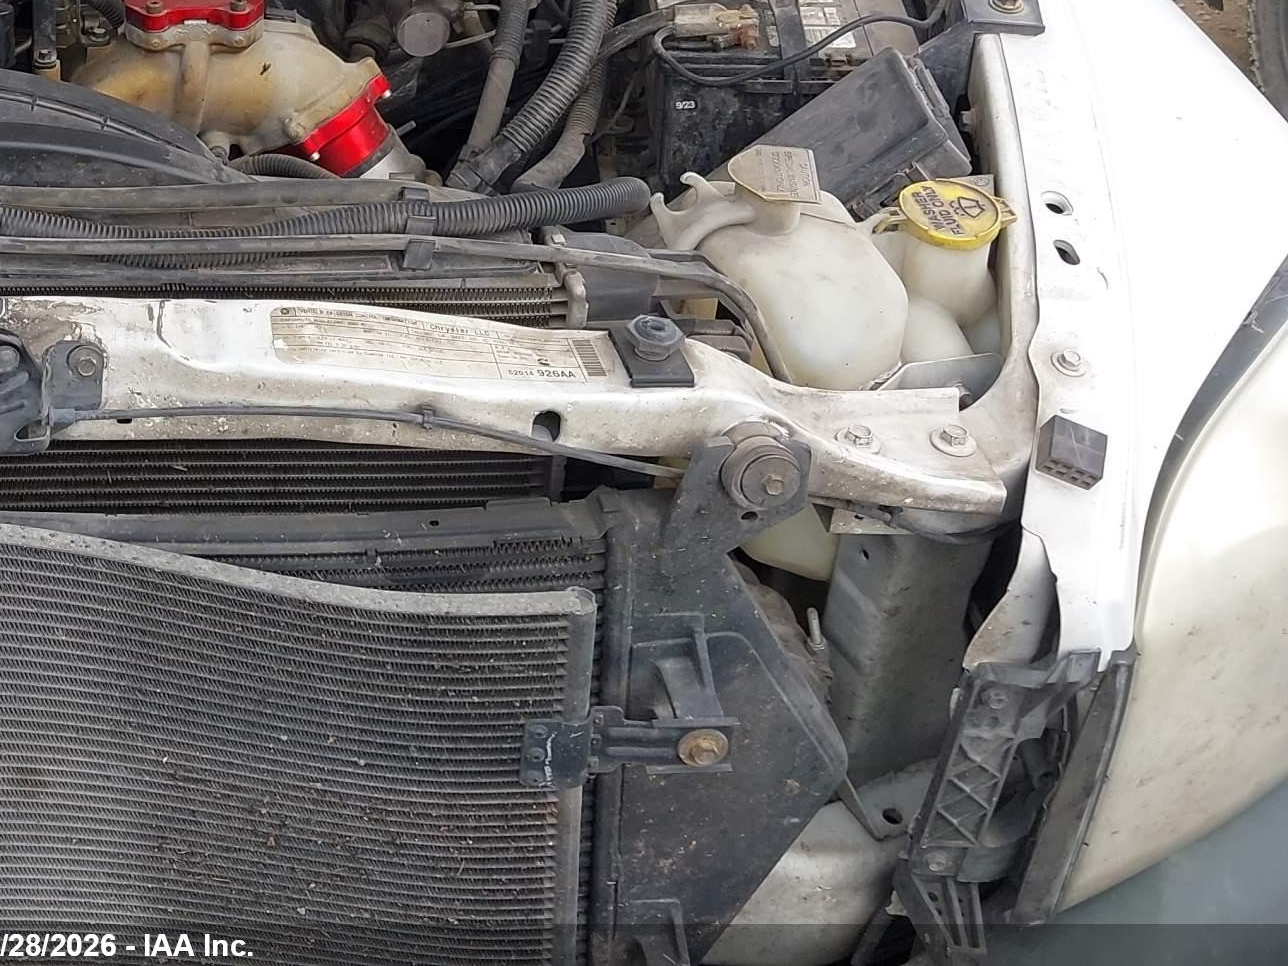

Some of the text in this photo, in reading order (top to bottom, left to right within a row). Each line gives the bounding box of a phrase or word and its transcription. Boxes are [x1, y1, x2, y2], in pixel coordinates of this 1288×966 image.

[675, 100, 696, 110] 9/23
[911, 191, 946, 231] WASHER
[920, 185, 966, 235] FLUID ONLY
[429, 323, 469, 334] Chrysler
[536, 368, 576, 378] 926AA
